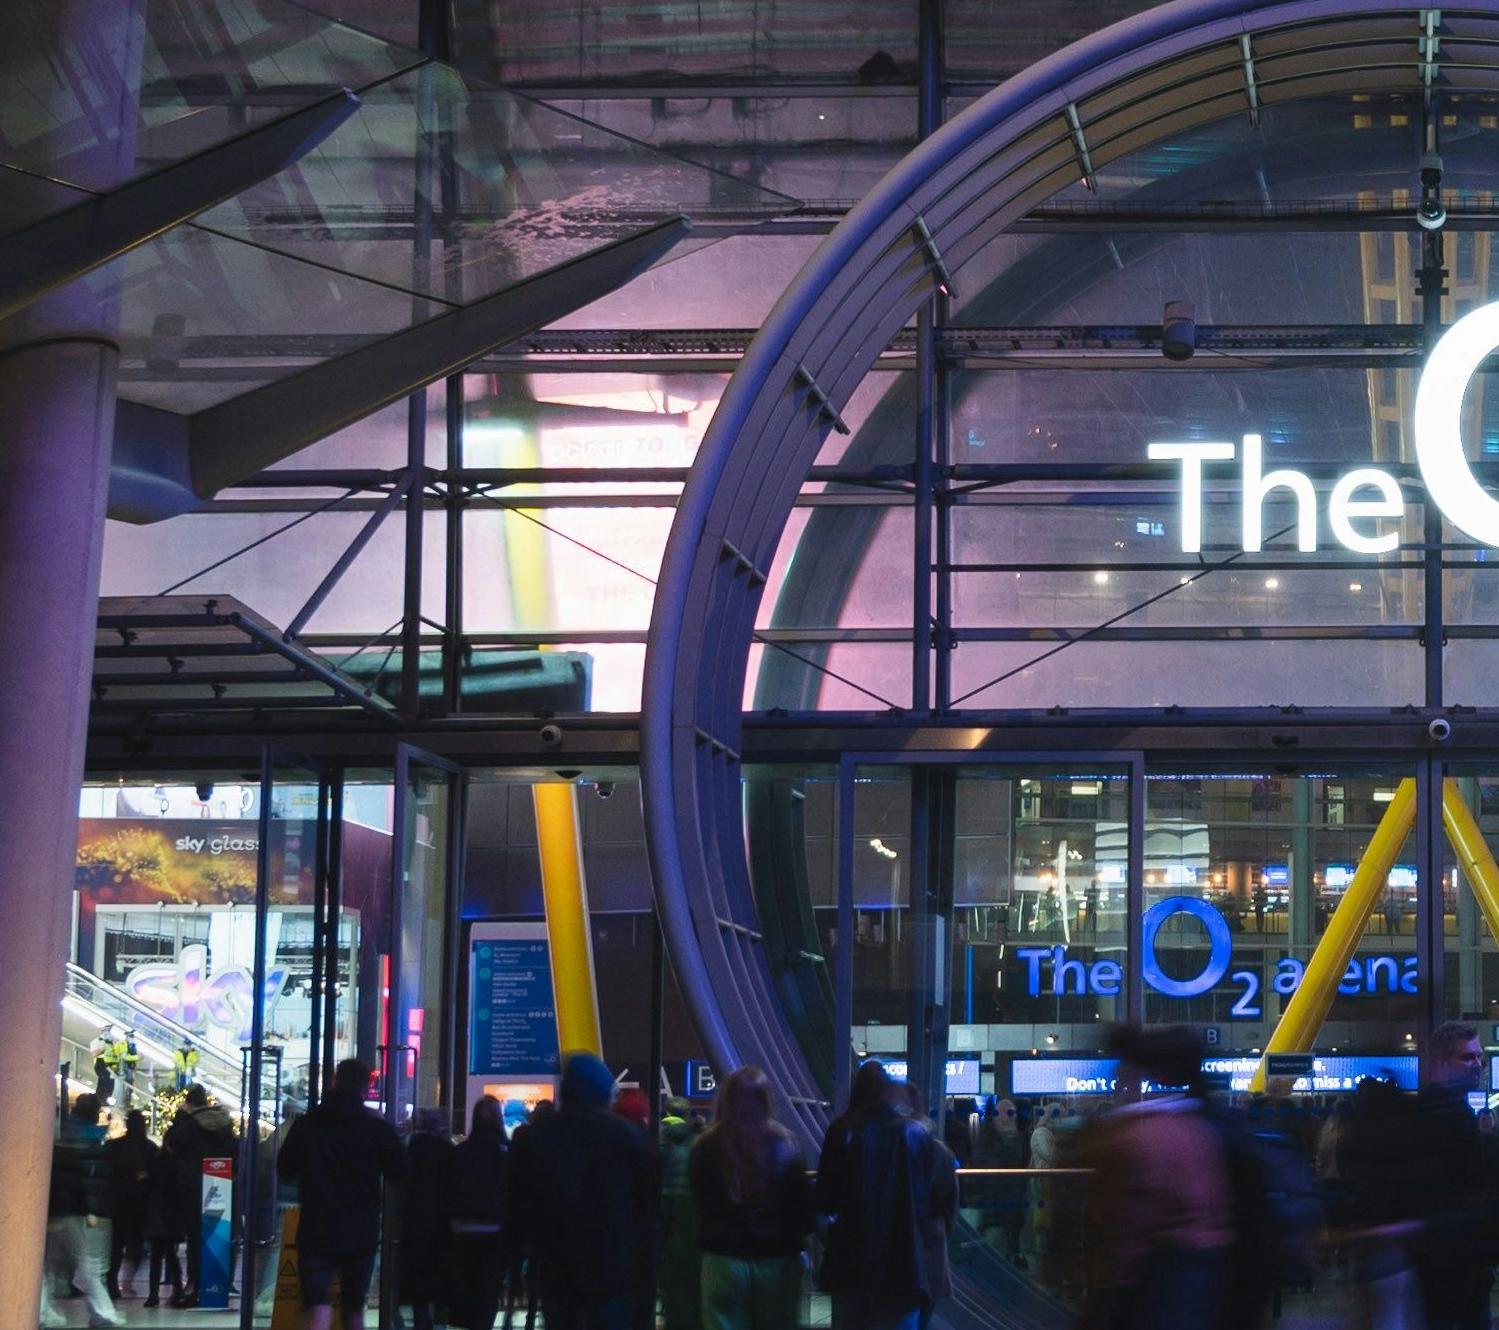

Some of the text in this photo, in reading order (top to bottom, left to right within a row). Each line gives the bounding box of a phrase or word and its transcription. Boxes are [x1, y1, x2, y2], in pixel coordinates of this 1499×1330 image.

[1146, 434, 1404, 554] The
[176, 835, 205, 853] sky
[129, 946, 290, 1046] sky
[1015, 945, 1124, 999] The
[1142, 895, 1262, 1019] O2
[1207, 1028, 1218, 1044] B
